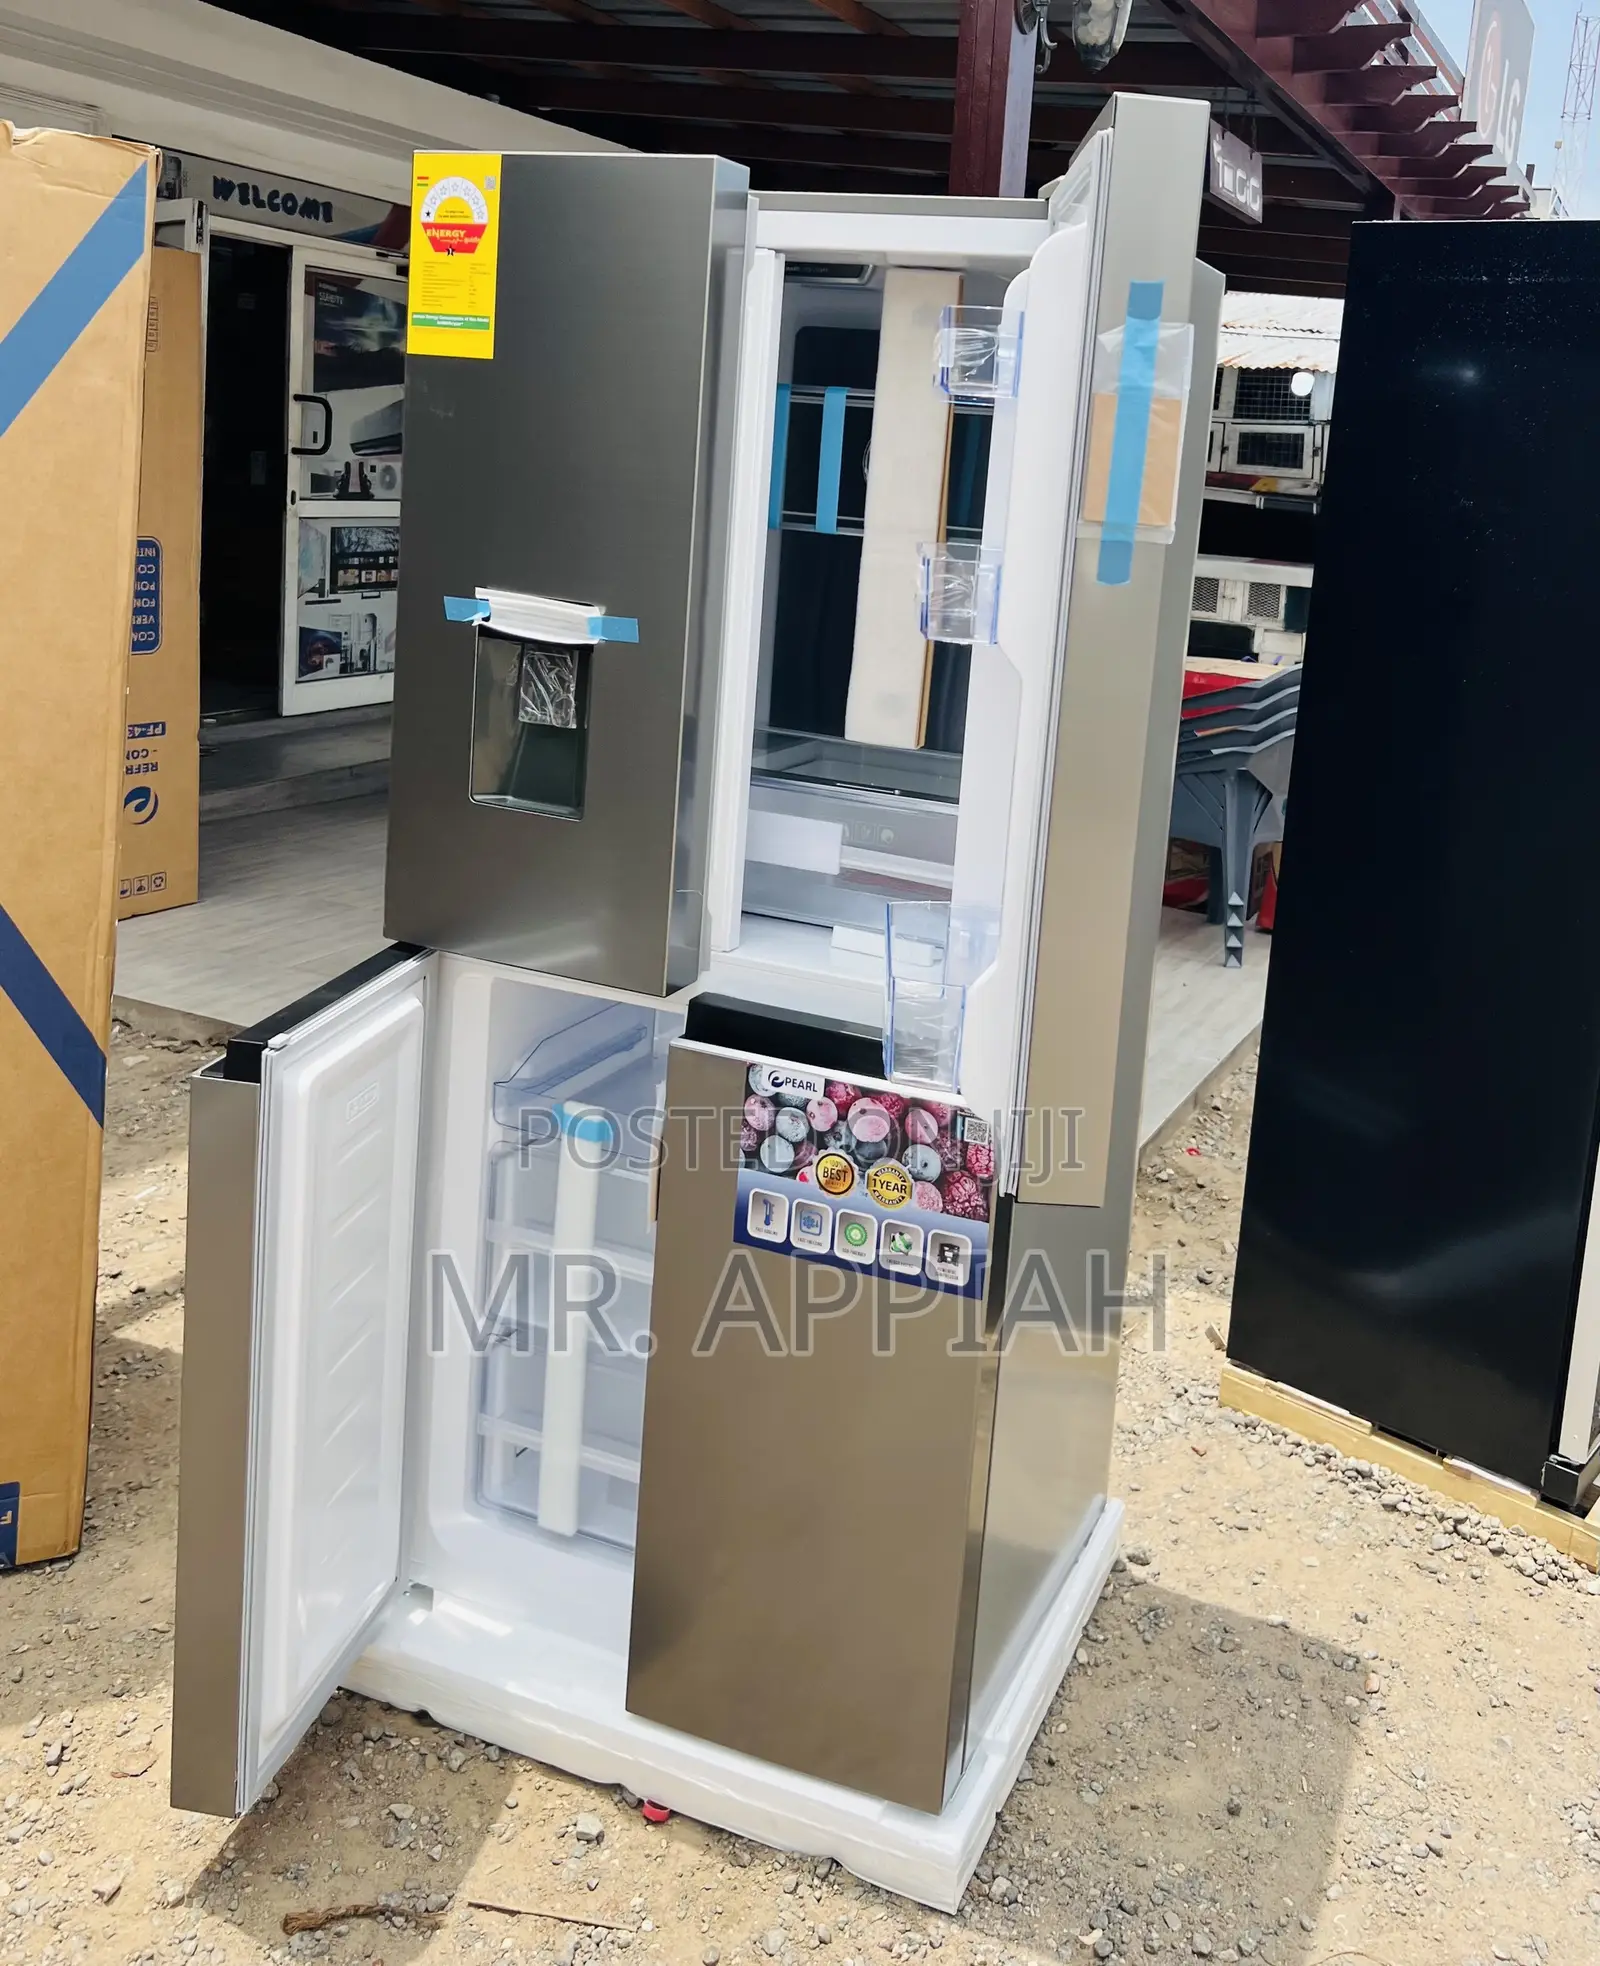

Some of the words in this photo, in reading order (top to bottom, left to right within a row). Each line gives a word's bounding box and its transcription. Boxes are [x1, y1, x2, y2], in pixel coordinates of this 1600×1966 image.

[212, 175, 334, 223] WELCOME
[426, 226, 467, 239] ENERGY
[135, 564, 156, 574] CO
[784, 1076, 818, 1092] PEARL
[823, 1166, 848, 1182] BEST
[876, 1167, 906, 1183] WARRANTY
[872, 1178, 877, 1187] 1
[879, 1179, 907, 1195] YEAR
